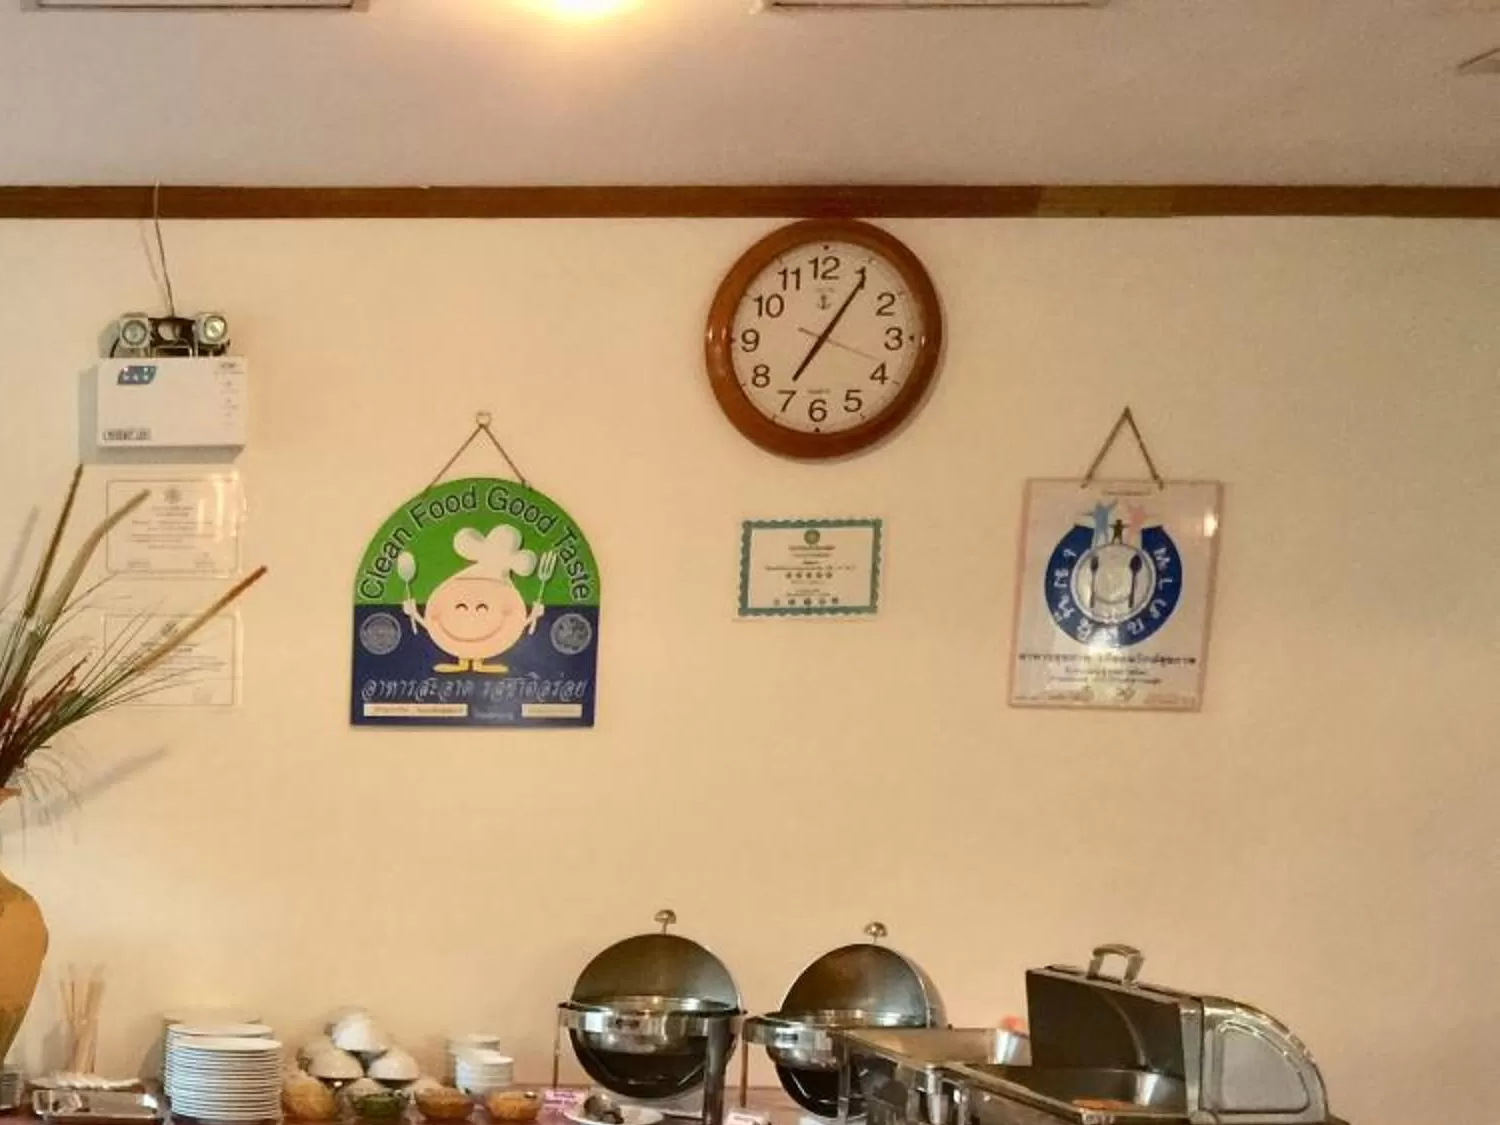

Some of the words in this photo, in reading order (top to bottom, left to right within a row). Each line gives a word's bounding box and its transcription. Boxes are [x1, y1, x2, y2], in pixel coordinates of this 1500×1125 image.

[777, 267, 801, 291] 11
[808, 255, 841, 281] 12
[854, 266, 867, 290] 1
[753, 293, 785, 319] 10
[875, 292, 896, 317] 2
[740, 328, 760, 353] 9
[884, 326, 904, 351] 3
[751, 363, 771, 389] 8
[869, 362, 889, 385] 4
[777, 389, 797, 413] 7
[808, 398, 828, 423] 6
[843, 389, 863, 413] 5
[360, 525, 413, 601] Clean
[409, 486, 478, 529] Food
[486, 485, 559, 535] Good
[553, 526, 592, 602] Taste
